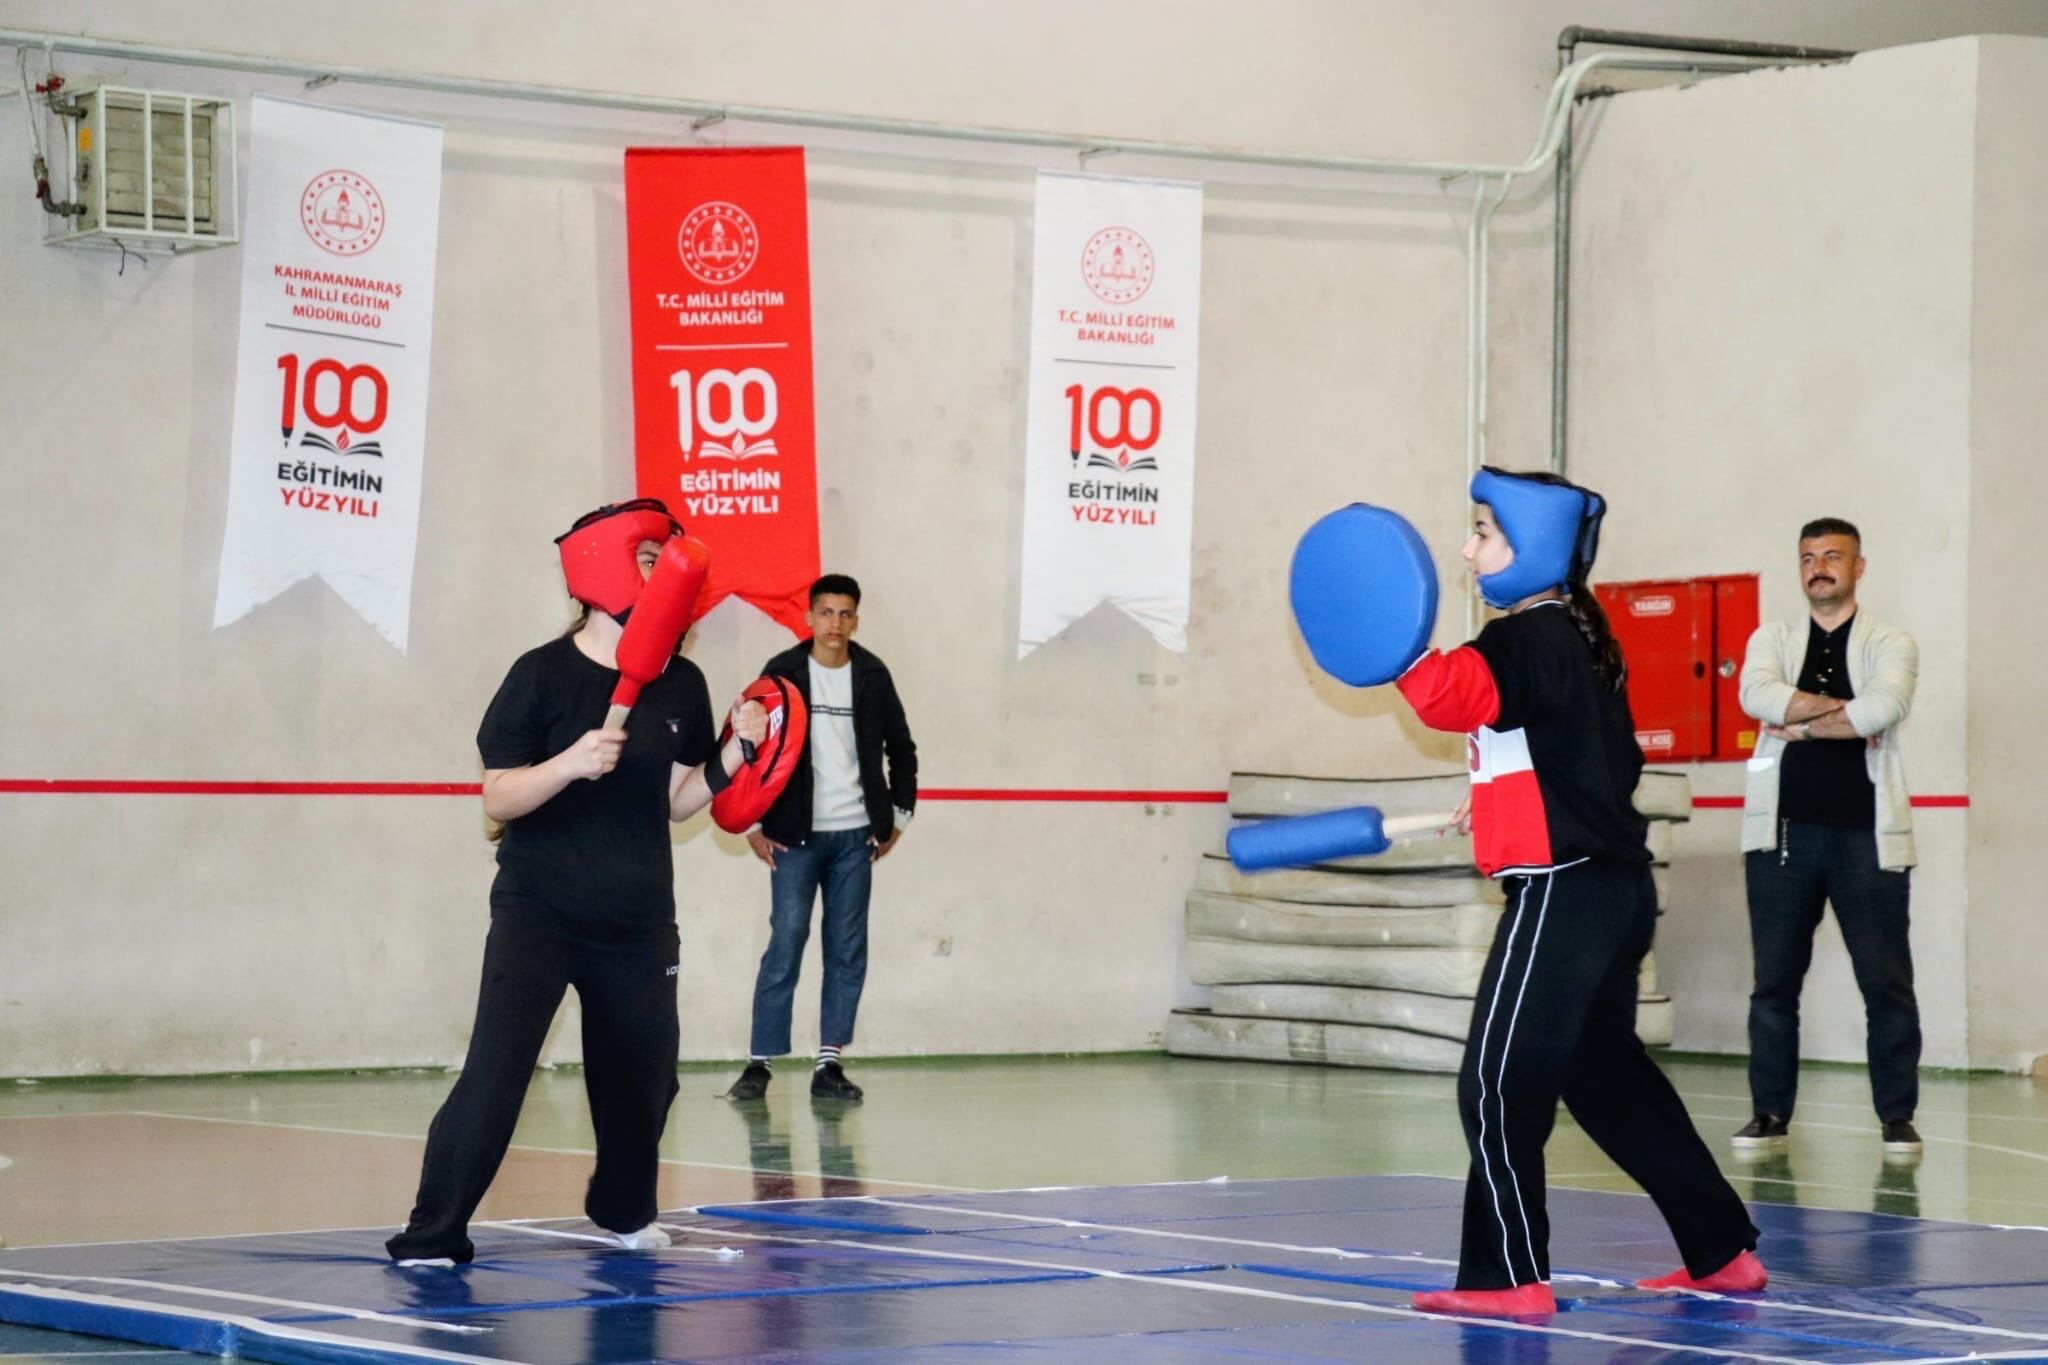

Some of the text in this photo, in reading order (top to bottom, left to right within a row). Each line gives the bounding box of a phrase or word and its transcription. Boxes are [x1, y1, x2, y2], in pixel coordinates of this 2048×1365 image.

[274, 264, 403, 298] KAHRAMANMARAŞ
[285, 282, 390, 311] İL MİLLİ EĞİTİM
[656, 289, 784, 308] T.C. MİLLİ EĞİTİM
[292, 304, 382, 329] MÜDÜRLÜĞÜ
[679, 308, 763, 326] BAKANLIĞI
[1058, 309, 1175, 329] T.C. MİLLİ EĞİTİM
[1077, 328, 1154, 345] BAKANLIĞI
[277, 353, 388, 440] 100
[669, 367, 778, 456] 100
[1065, 383, 1161, 456] 100
[277, 461, 383, 493] EĞİTİMİN
[680, 468, 780, 492] EĞİTİMİN
[280, 487, 378, 518] YÜZYILI
[1068, 480, 1159, 503] EĞİTİMİN
[685, 494, 779, 516] YÜZYILI
[1072, 503, 1156, 526] YÜZYILI
